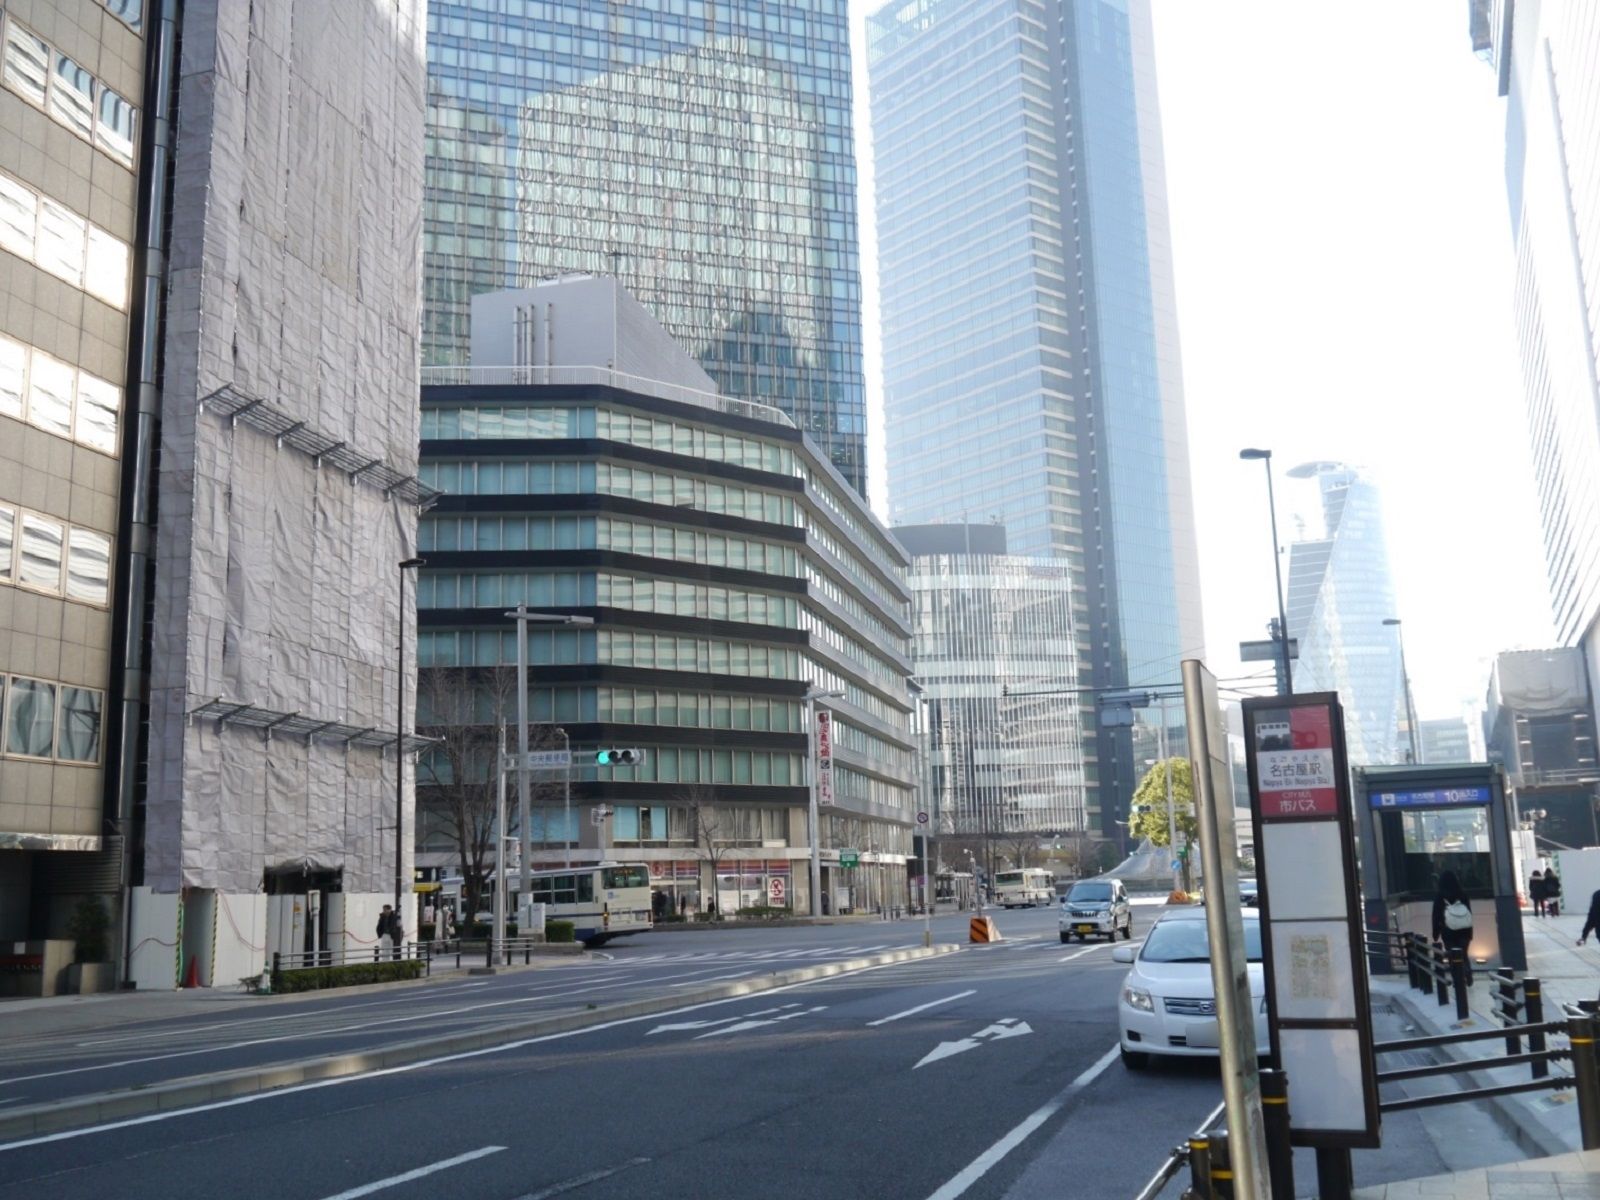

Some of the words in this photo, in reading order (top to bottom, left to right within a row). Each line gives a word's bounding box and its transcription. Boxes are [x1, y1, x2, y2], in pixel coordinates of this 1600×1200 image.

[1270, 762, 1322, 777] 名古屋駅
[1282, 791, 1297, 799] CITY
[1443, 790, 1459, 803] 10
[1279, 799, 1317, 812] 市バス
